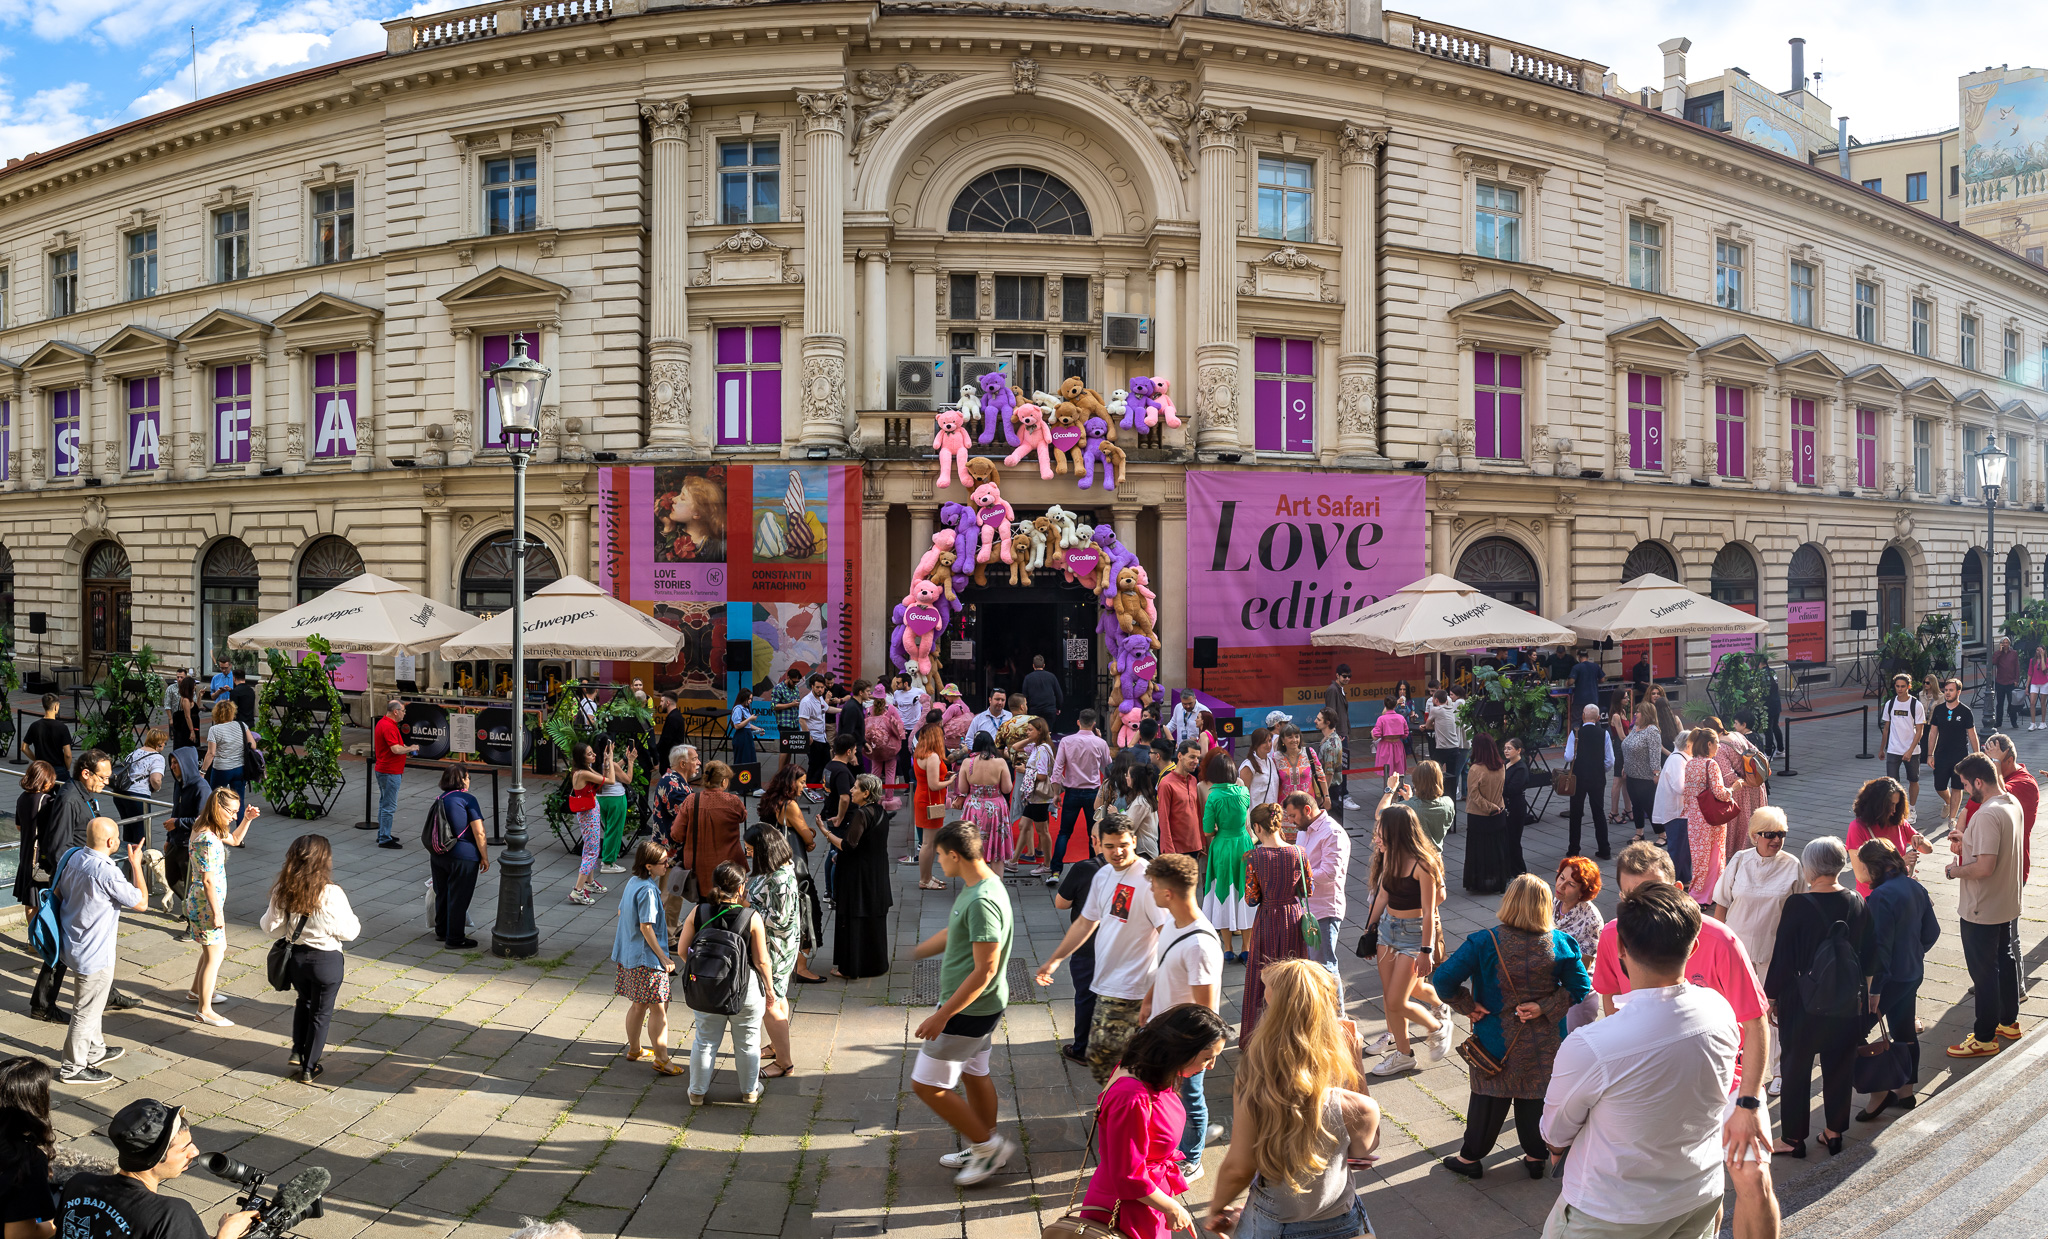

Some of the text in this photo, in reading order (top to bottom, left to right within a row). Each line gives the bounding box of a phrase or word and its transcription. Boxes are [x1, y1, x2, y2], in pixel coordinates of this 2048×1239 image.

[58, 428, 80, 473] S
[130, 419, 160, 467] A
[220, 408, 251, 460] F
[315, 398, 357, 453] A
[1053, 432, 1078, 440] Coccolino
[1275, 494, 1380, 517] Art Safari
[981, 509, 1005, 520] Coccolino
[601, 489, 624, 578] expoziții
[1205, 500, 1384, 572] Love
[1069, 554, 1097, 562] Coccolino
[654, 569, 677, 578] LOVE
[752, 570, 812, 580] CONSTANTIN
[845, 559, 853, 597] Art Safari
[654, 580, 691, 590] STORIES
[752, 581, 806, 591] ARTACHINO
[1650, 598, 1695, 619] Schweppes
[1788, 605, 1803, 614] ove
[291, 605, 364, 629] Schweppes
[909, 612, 937, 622] Coccolino
[1442, 602, 1492, 628] Schweppes
[357, 643, 373, 651] 1783
[509, 647, 638, 658] Cnstruiește caractere din 1783
[1134, 661, 1155, 673] Coccolino
[1297, 689, 1312, 701] 30
[1350, 686, 1361, 697] 10
[412, 726, 447, 737] BACARDÍ
[537, 737, 547, 746] glo
[66, 1197, 81, 1209] NO
[83, 1196, 106, 1210] BAD
